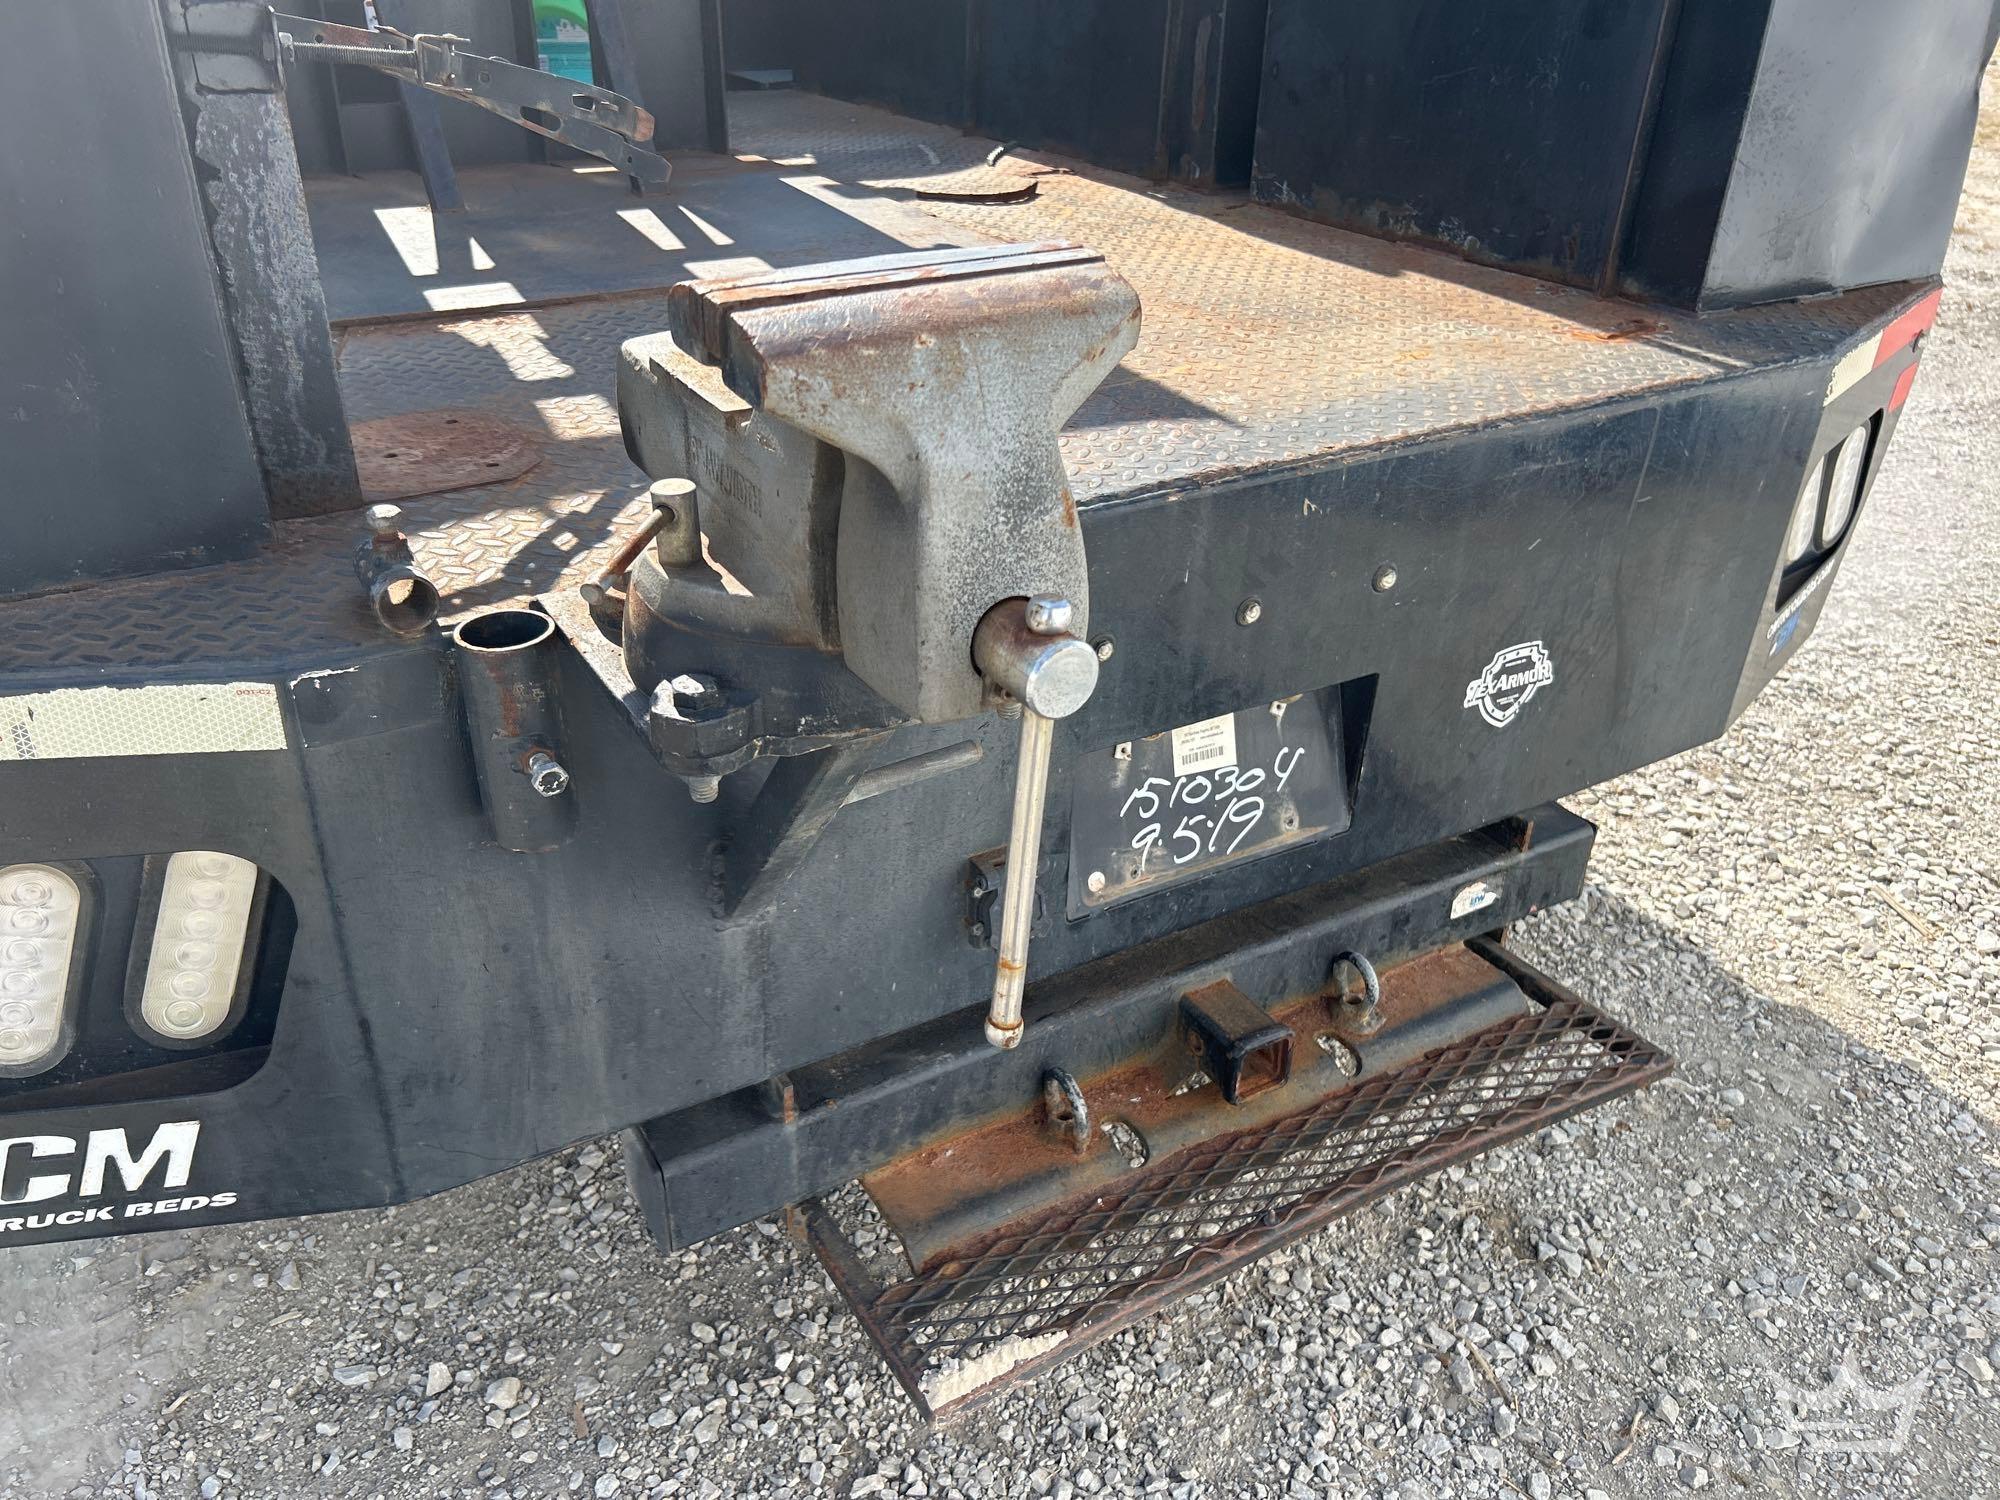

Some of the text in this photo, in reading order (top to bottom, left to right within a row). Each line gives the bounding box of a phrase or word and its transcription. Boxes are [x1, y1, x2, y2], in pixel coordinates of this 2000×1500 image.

[0, 1120, 201, 1205] CM
[0, 1192, 238, 1232] RUCK BEDS
